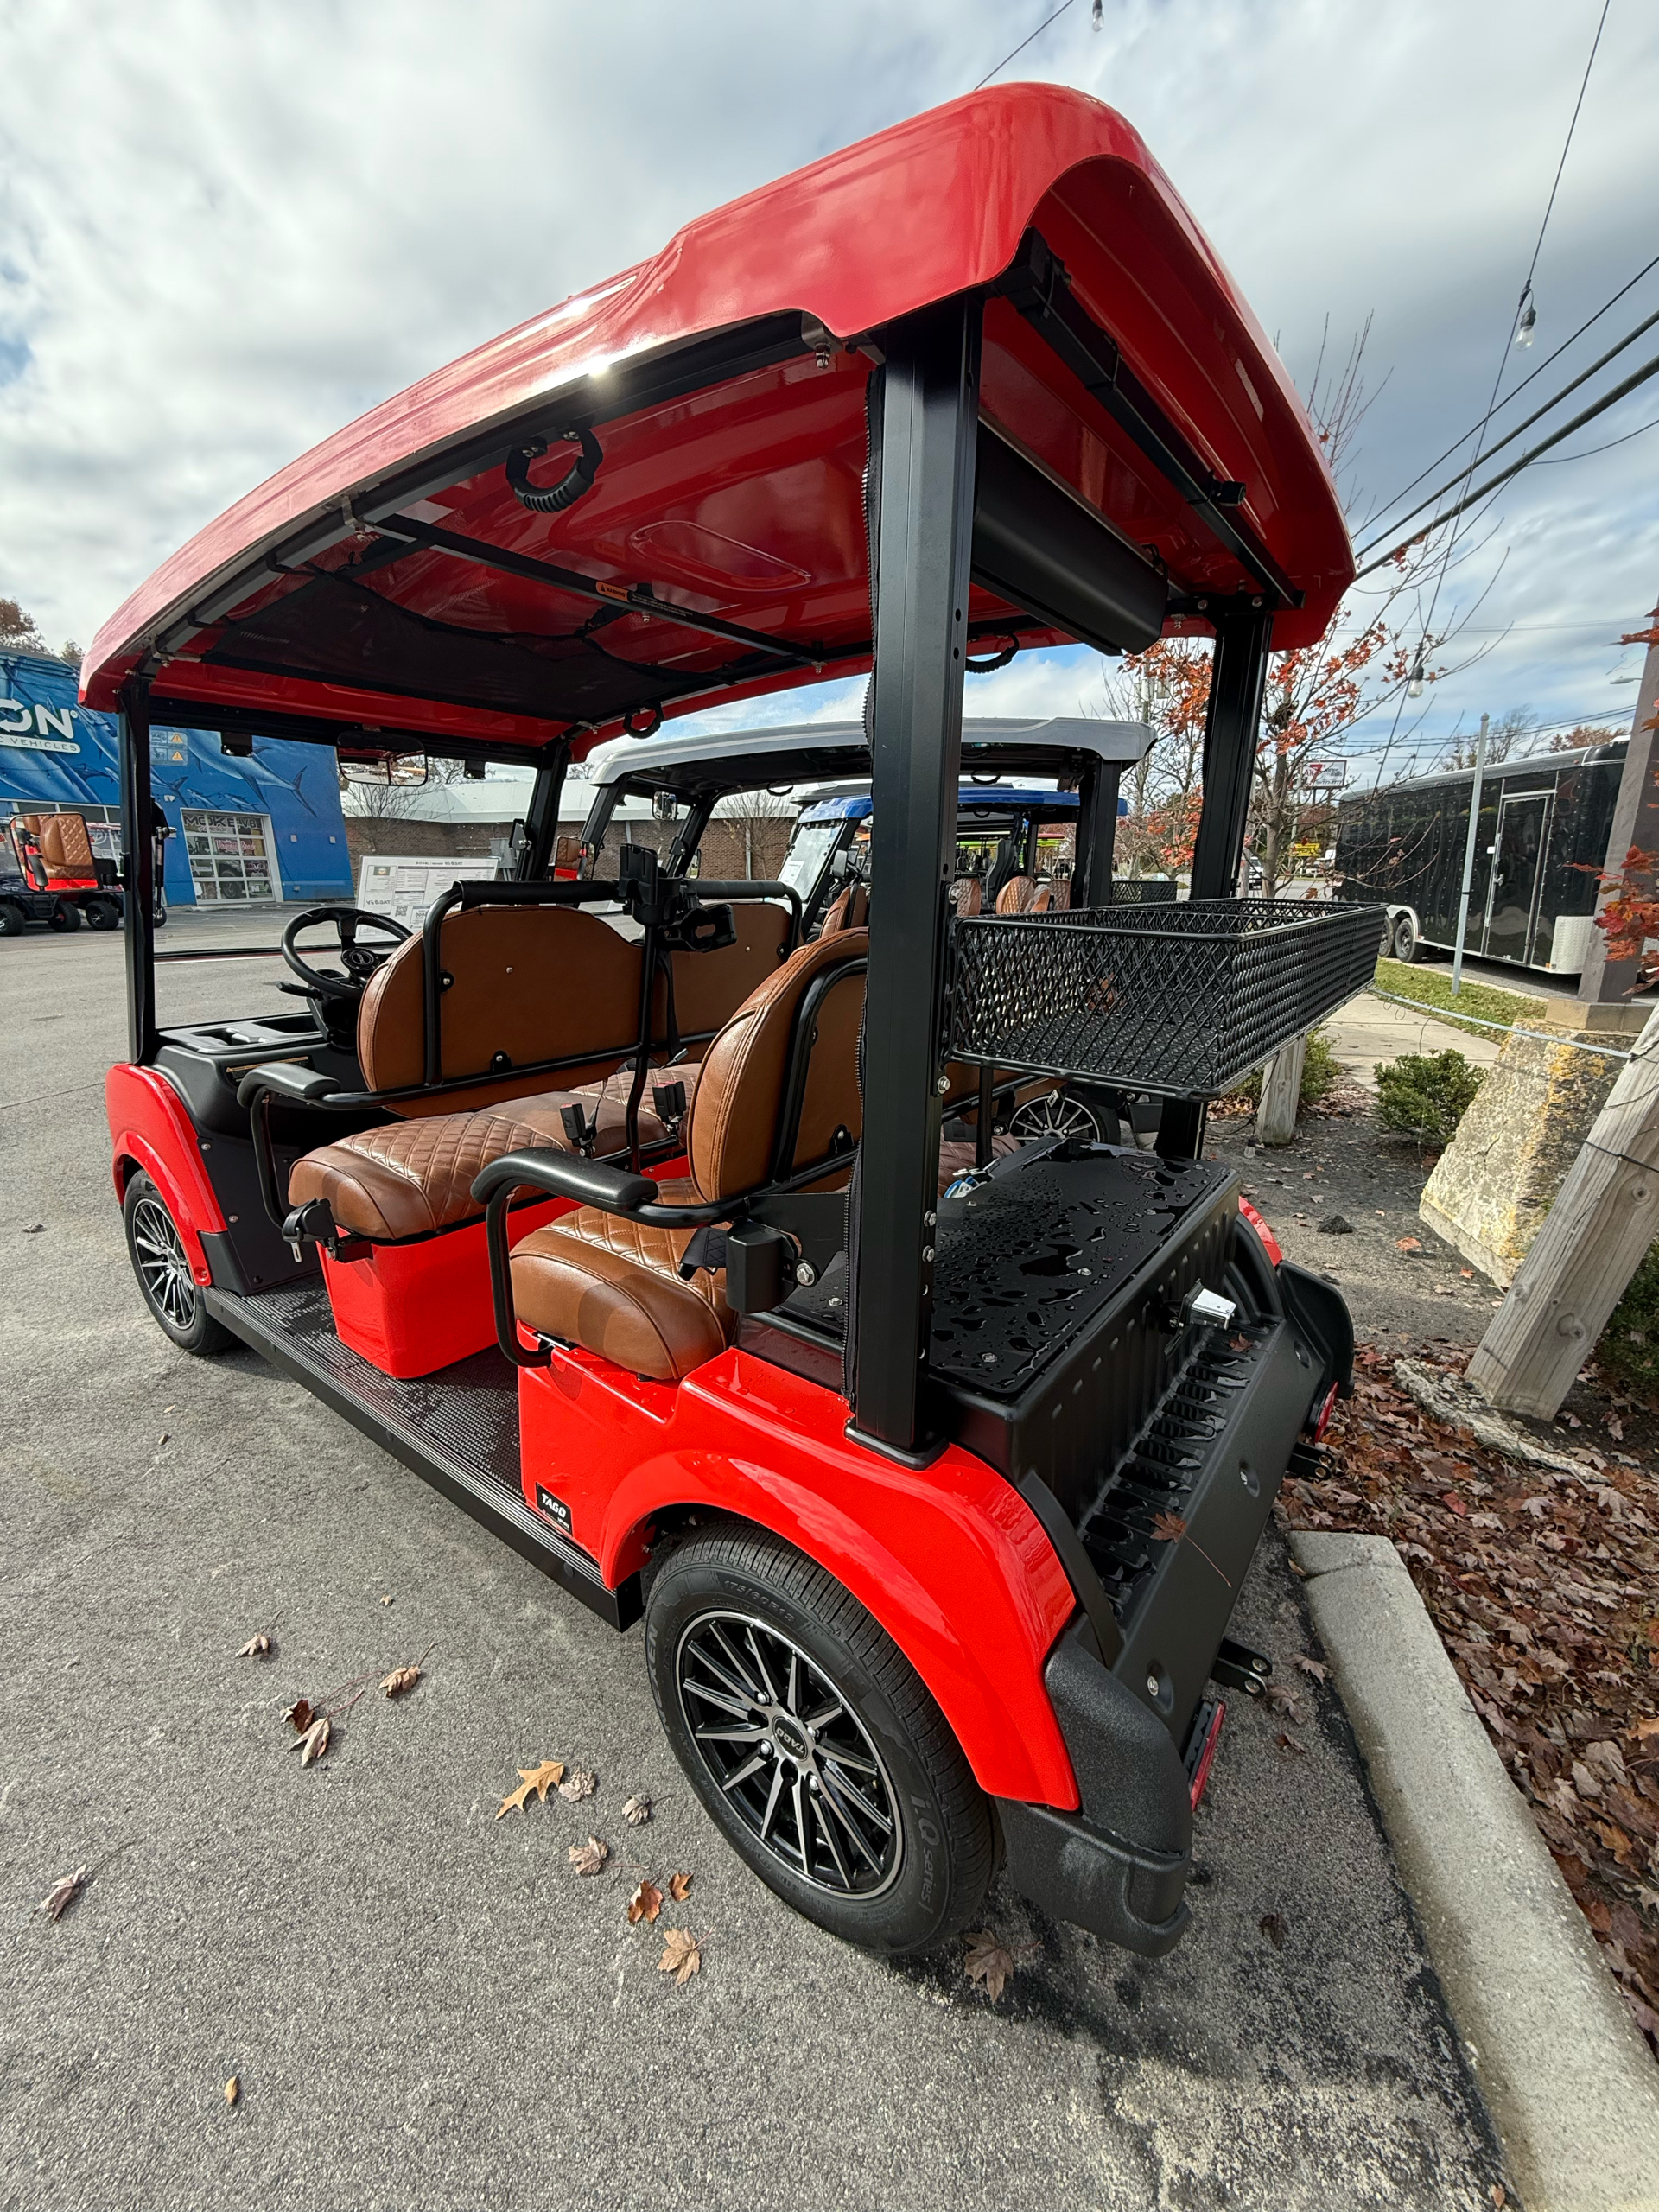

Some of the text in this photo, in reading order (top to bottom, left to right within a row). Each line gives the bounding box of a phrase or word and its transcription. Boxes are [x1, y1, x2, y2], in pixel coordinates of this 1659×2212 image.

[10, 737, 77, 752] VEHICLES
[183, 815, 235, 828] MOKE
[541, 1492, 567, 1519] TAGO
[775, 1726, 804, 1754] TAGO
